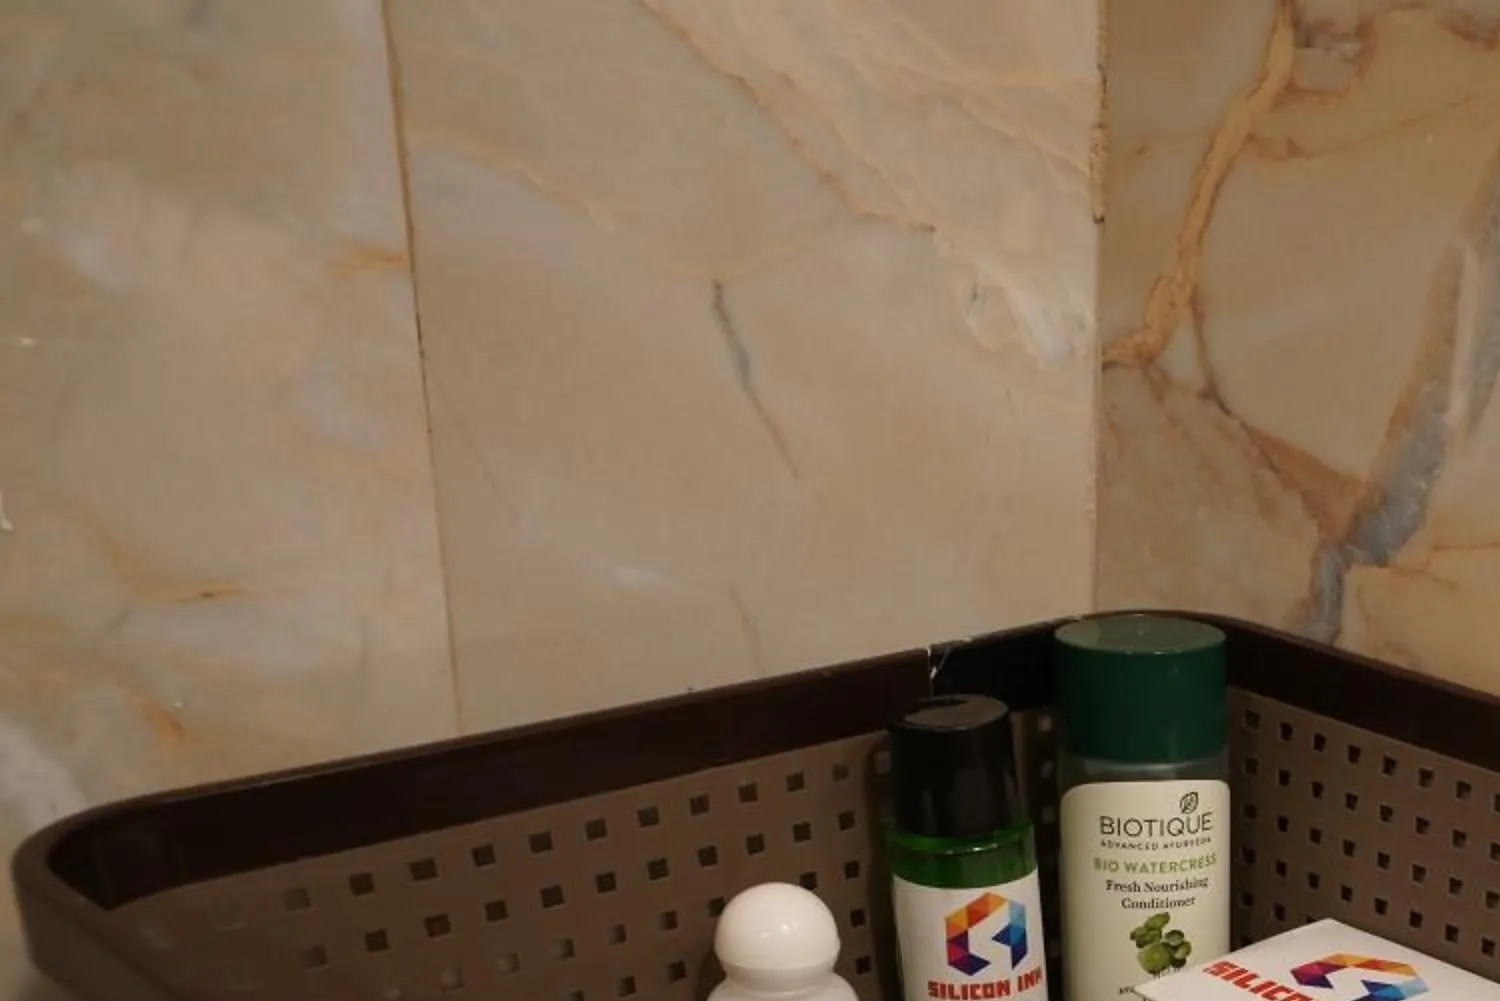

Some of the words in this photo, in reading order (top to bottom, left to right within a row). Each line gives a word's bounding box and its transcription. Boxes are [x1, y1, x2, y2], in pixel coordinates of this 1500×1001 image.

[1100, 811, 1214, 837] BIOTIQUE
[1101, 839, 1158, 851] ADVANCED
[1164, 836, 1211, 849] AYURVEDA
[1093, 857, 1119, 873] BIO
[1123, 852, 1217, 874] WATERCRESS
[1105, 879, 1141, 892] Fresh
[1144, 877, 1209, 893] Nourishing
[1121, 896, 1196, 909] Conditioner
[927, 979, 1010, 1000] SILICON
[1017, 967, 1042, 992] INN
